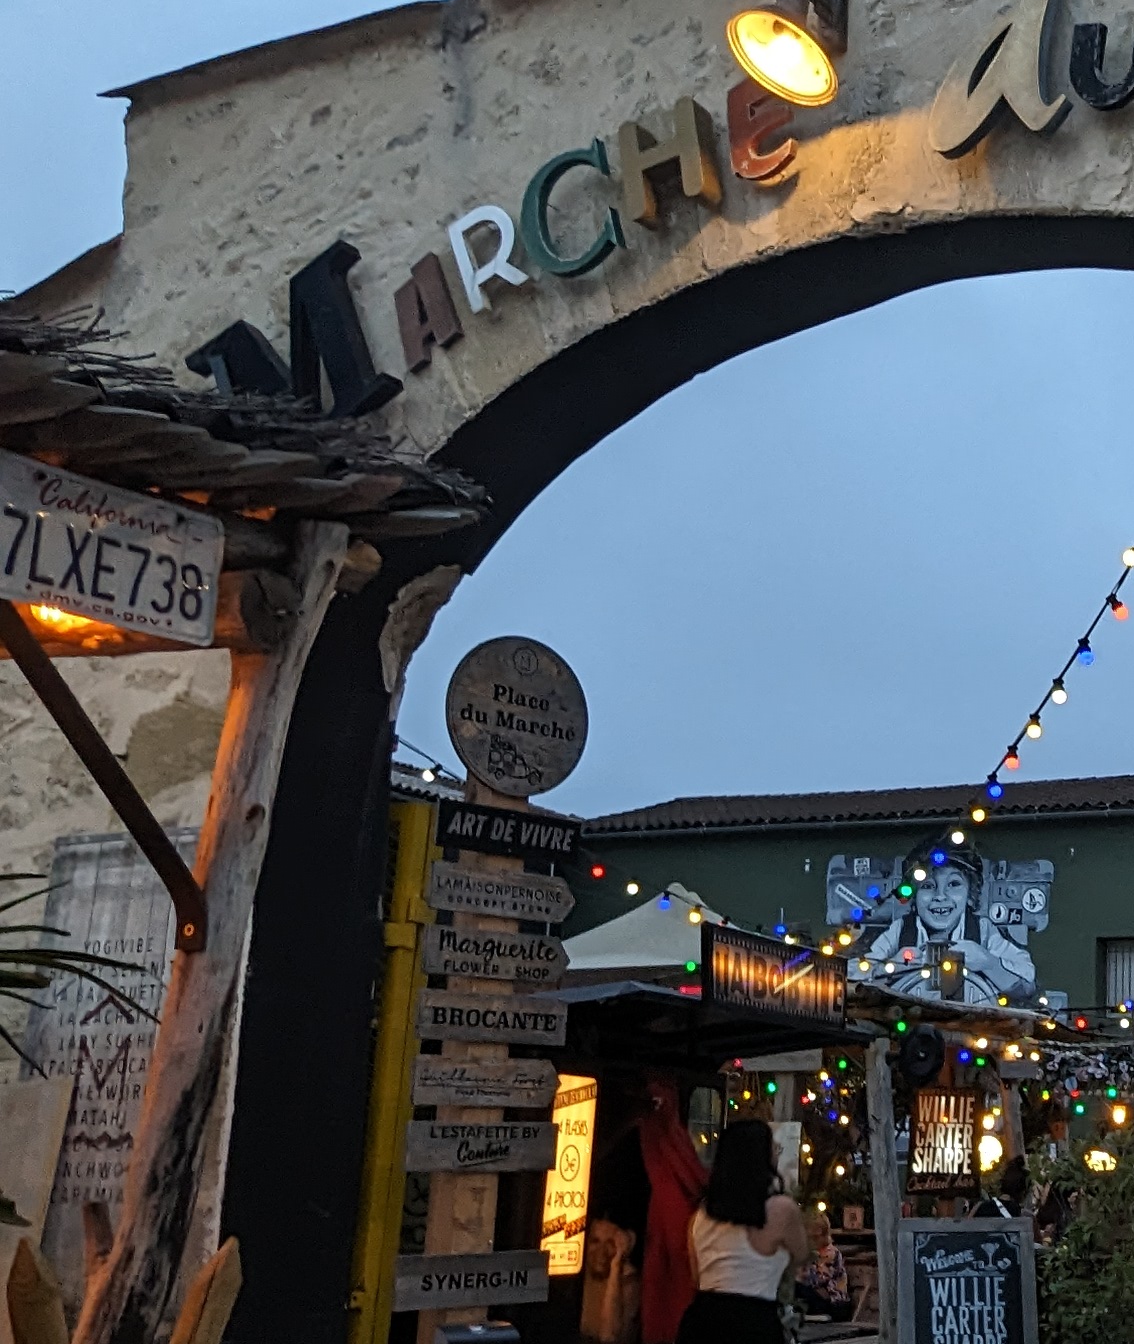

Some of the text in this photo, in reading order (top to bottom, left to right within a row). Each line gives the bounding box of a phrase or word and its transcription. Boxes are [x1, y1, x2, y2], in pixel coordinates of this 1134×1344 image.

[3, 508, 204, 621] 7LXE738
[493, 682, 550, 712] Place
[460, 703, 488, 724] du
[446, 811, 488, 839] ART
[520, 822, 575, 852] VIVRE
[444, 959, 550, 980] FLOWER SHOP
[431, 1006, 558, 1033] BROCANTE
[918, 1095, 975, 1123] WILLIE
[522, 1126, 541, 1139] BY
[915, 1122, 973, 1149] CARTER
[912, 1147, 973, 1175] SHARPE
[421, 1269, 529, 1293] SYNERG-IN
[929, 1276, 1005, 1306] WILLIE
[931, 1306, 1008, 1335] CARTER
